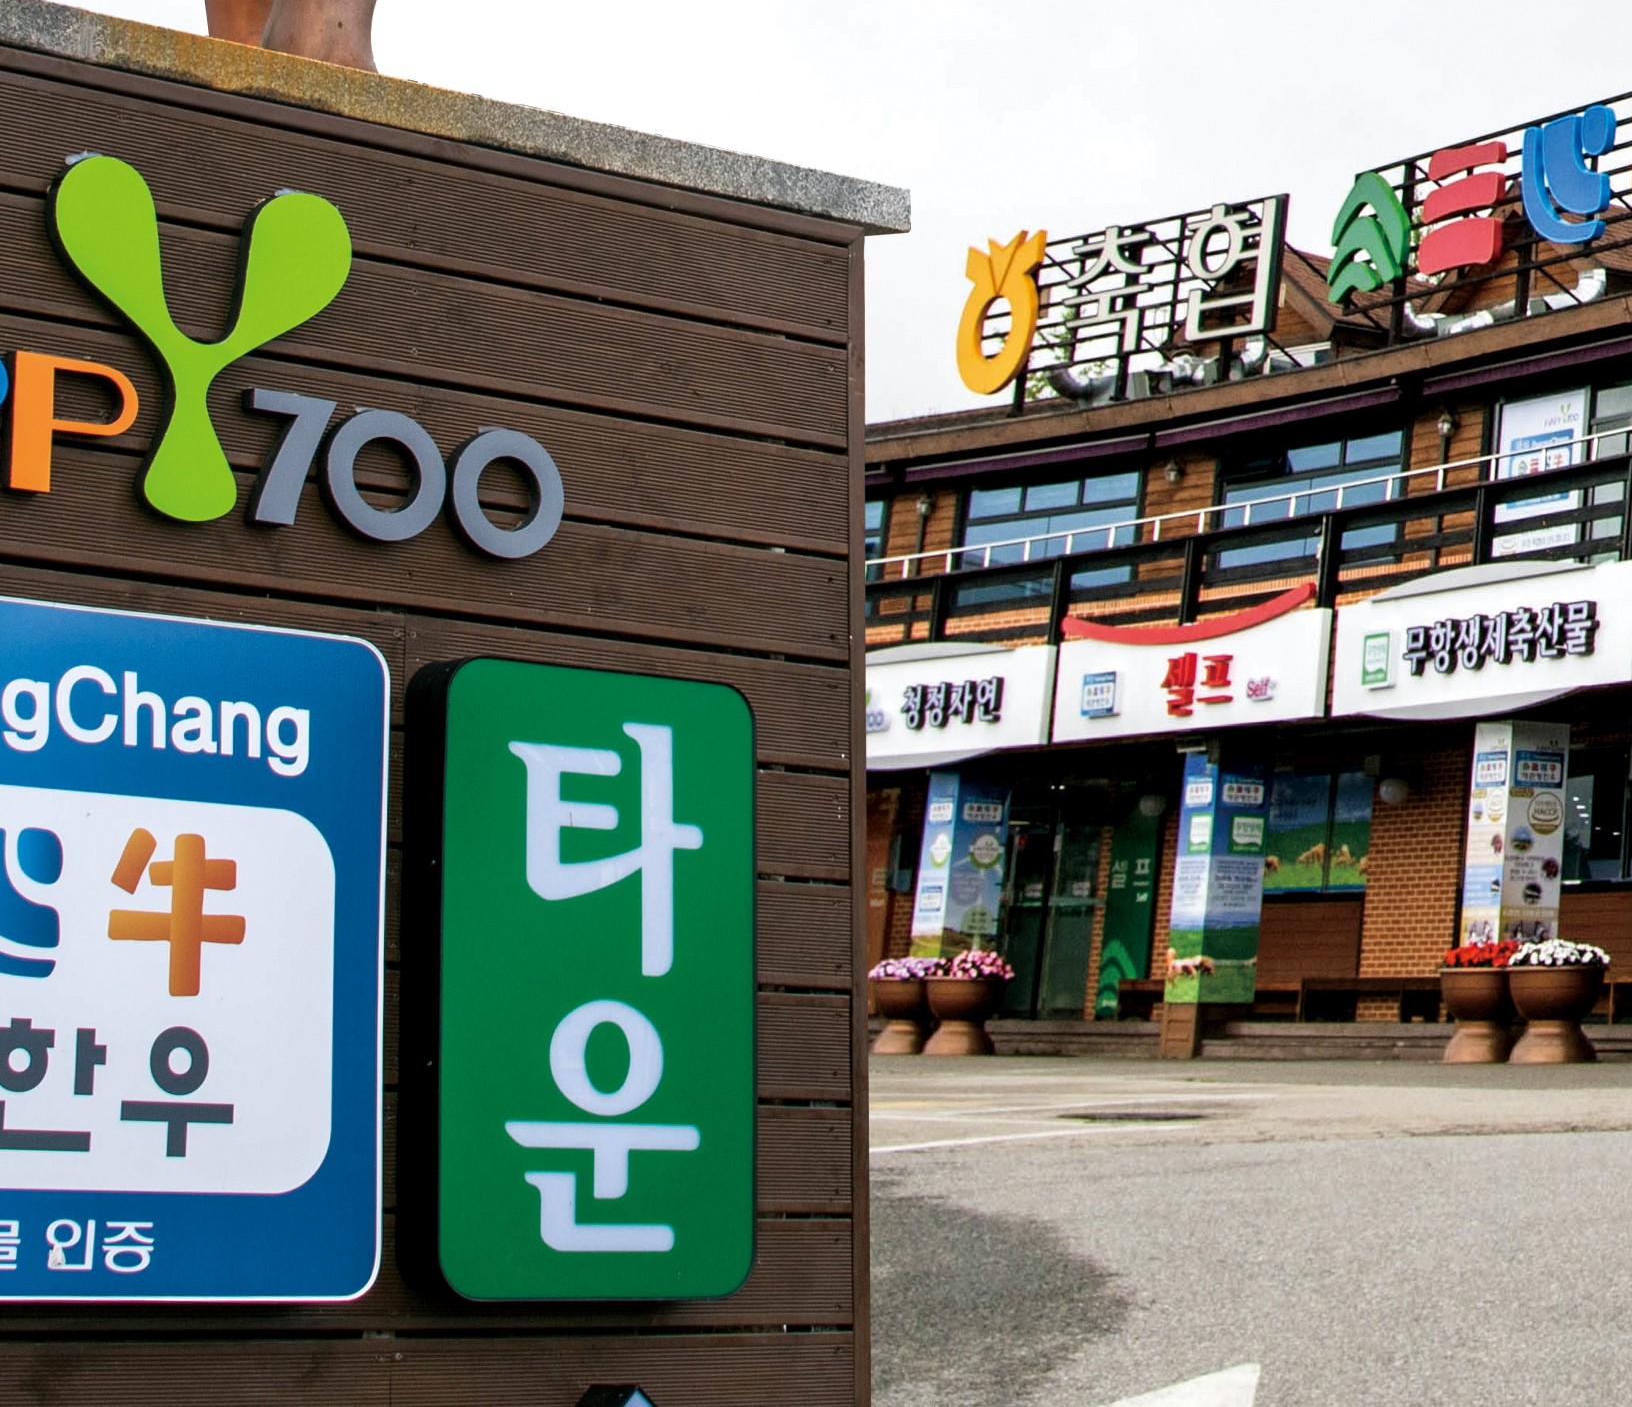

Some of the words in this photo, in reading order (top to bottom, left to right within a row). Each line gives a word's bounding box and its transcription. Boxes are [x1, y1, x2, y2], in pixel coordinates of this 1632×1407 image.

[1062, 196, 1282, 352] 축협
[1403, 601, 1596, 675] 무항생제축산물
[901, 676, 1004, 730] 청정자연
[1161, 652, 1233, 716] 셀프
[1247, 678, 1270, 699] Self
[507, 720, 704, 1255] 타운
[44, 1215, 156, 1275] 인증
